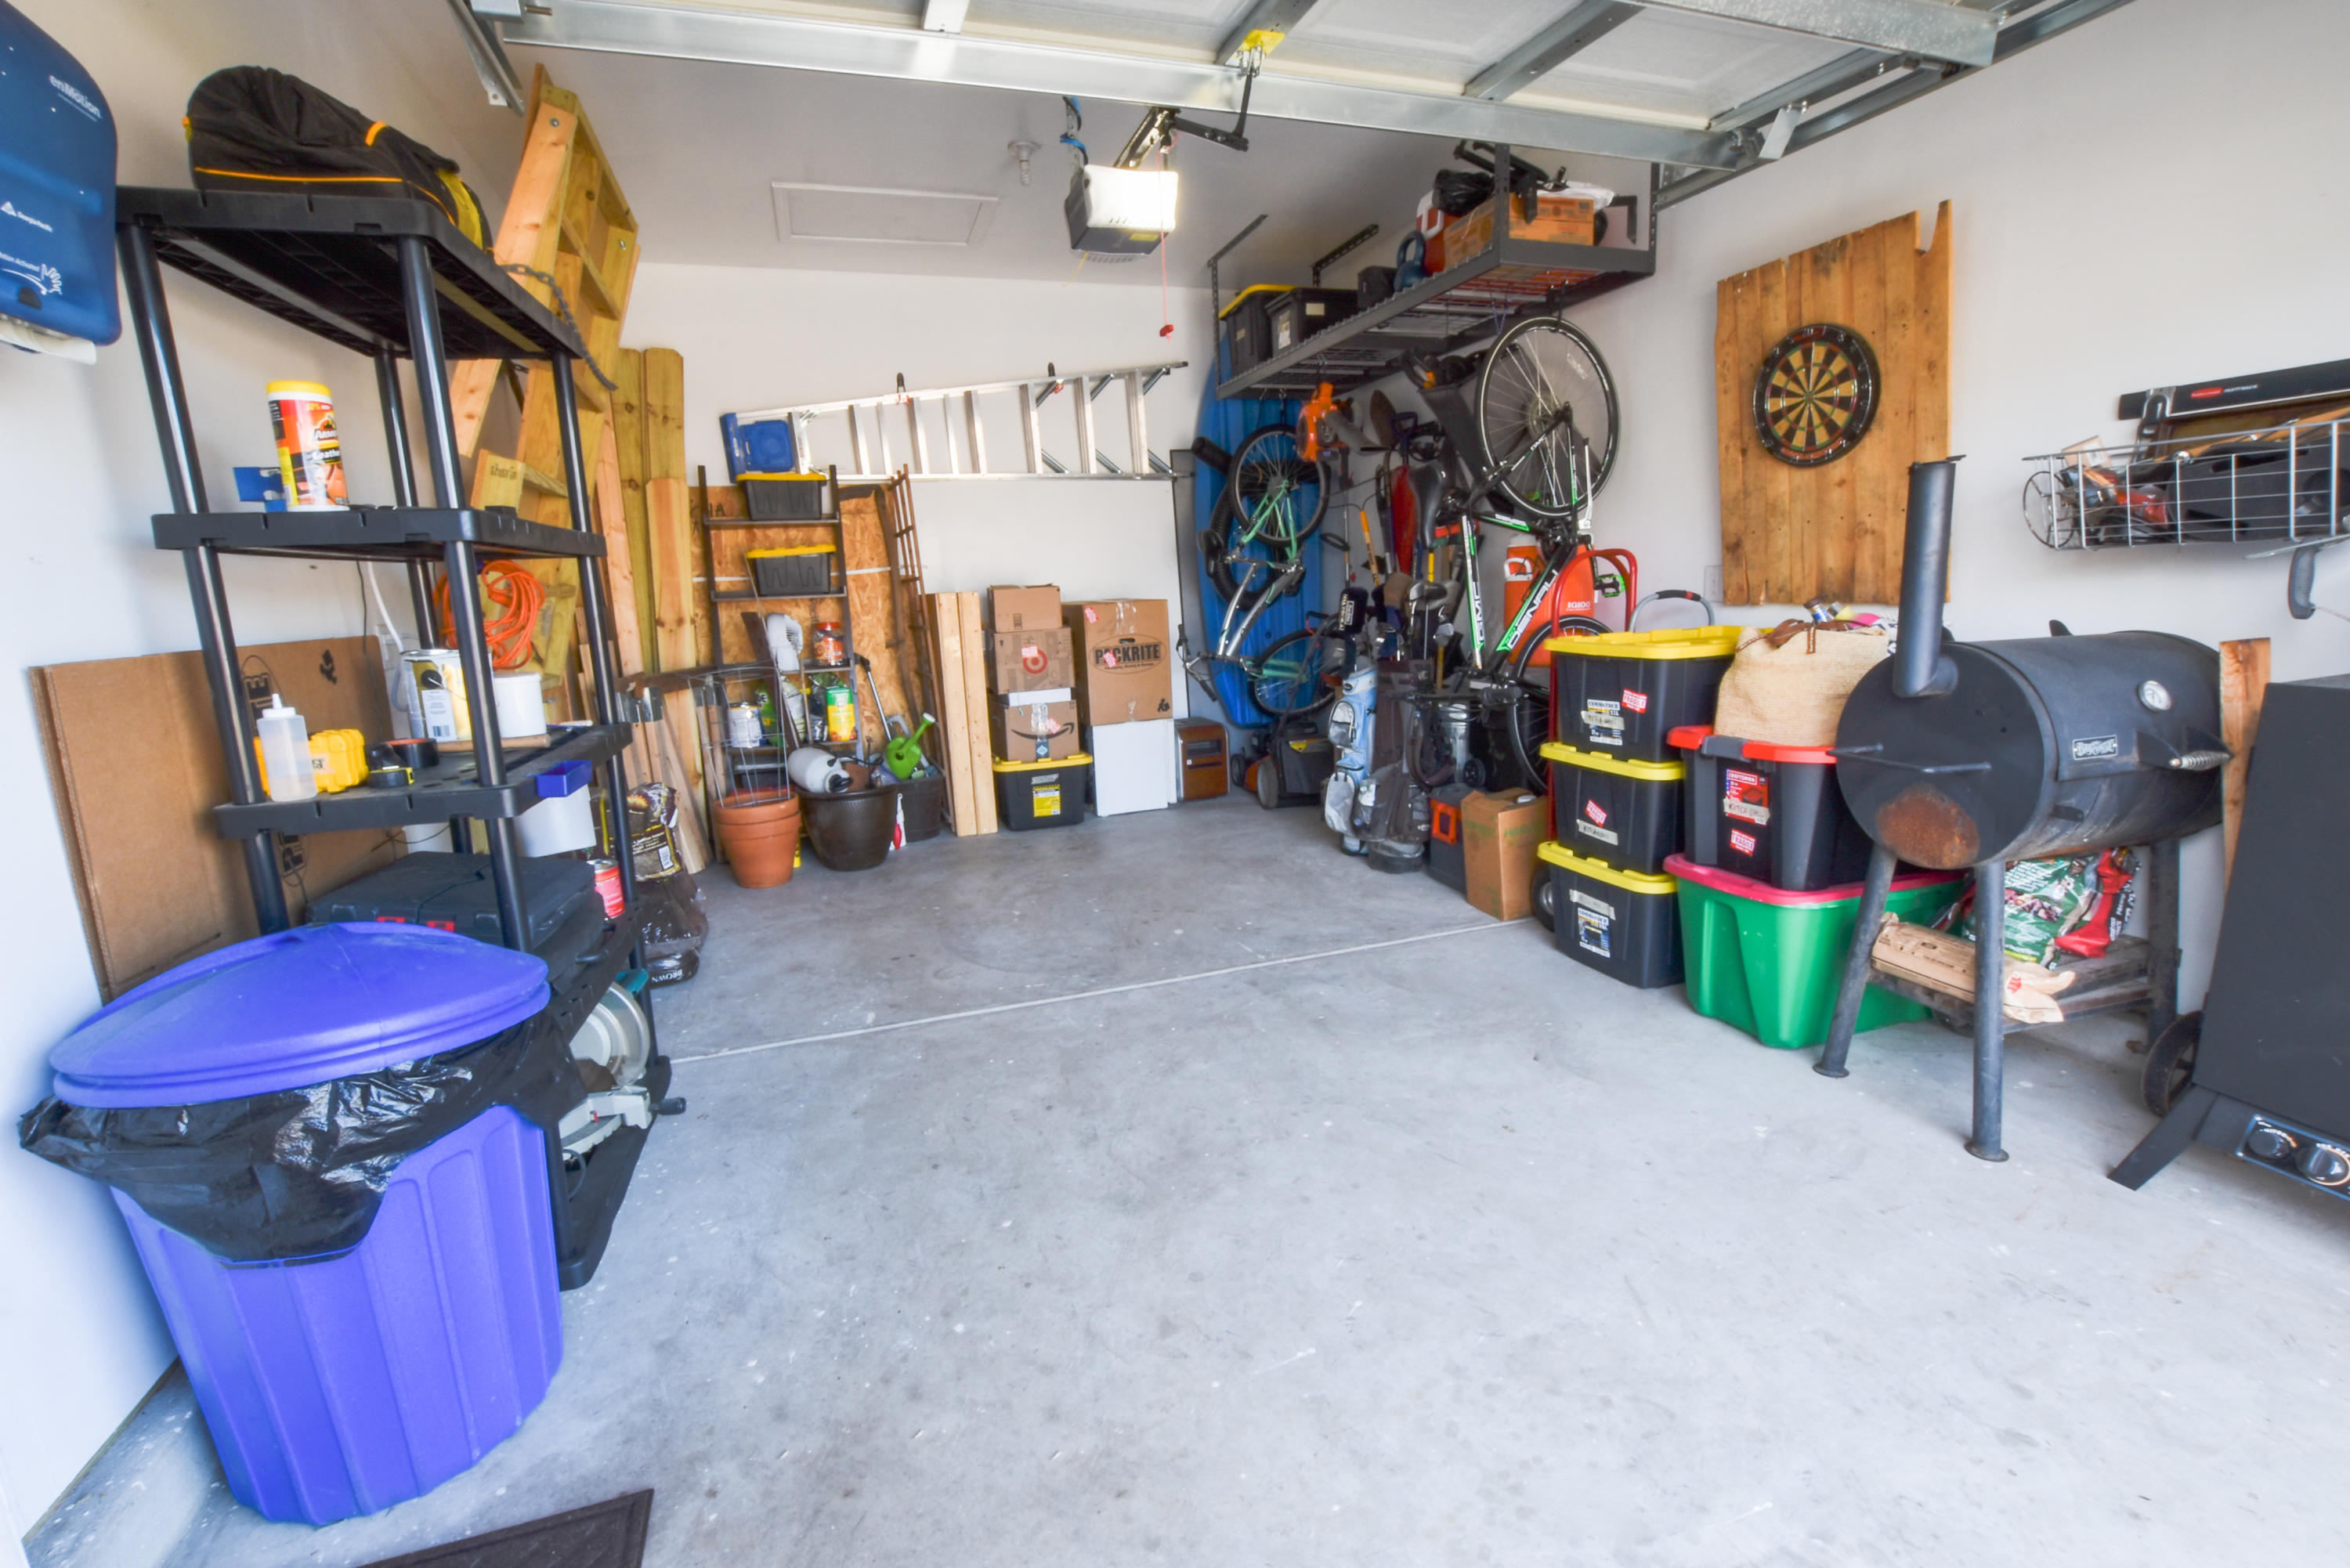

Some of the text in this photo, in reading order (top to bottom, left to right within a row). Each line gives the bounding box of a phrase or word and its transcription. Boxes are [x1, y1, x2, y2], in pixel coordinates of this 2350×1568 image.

[49, 74, 102, 119] enMotion
[1473, 581, 1485, 644] GMC
[1509, 569, 1559, 649] DENALI
[652, 969, 683, 983] BROWN
